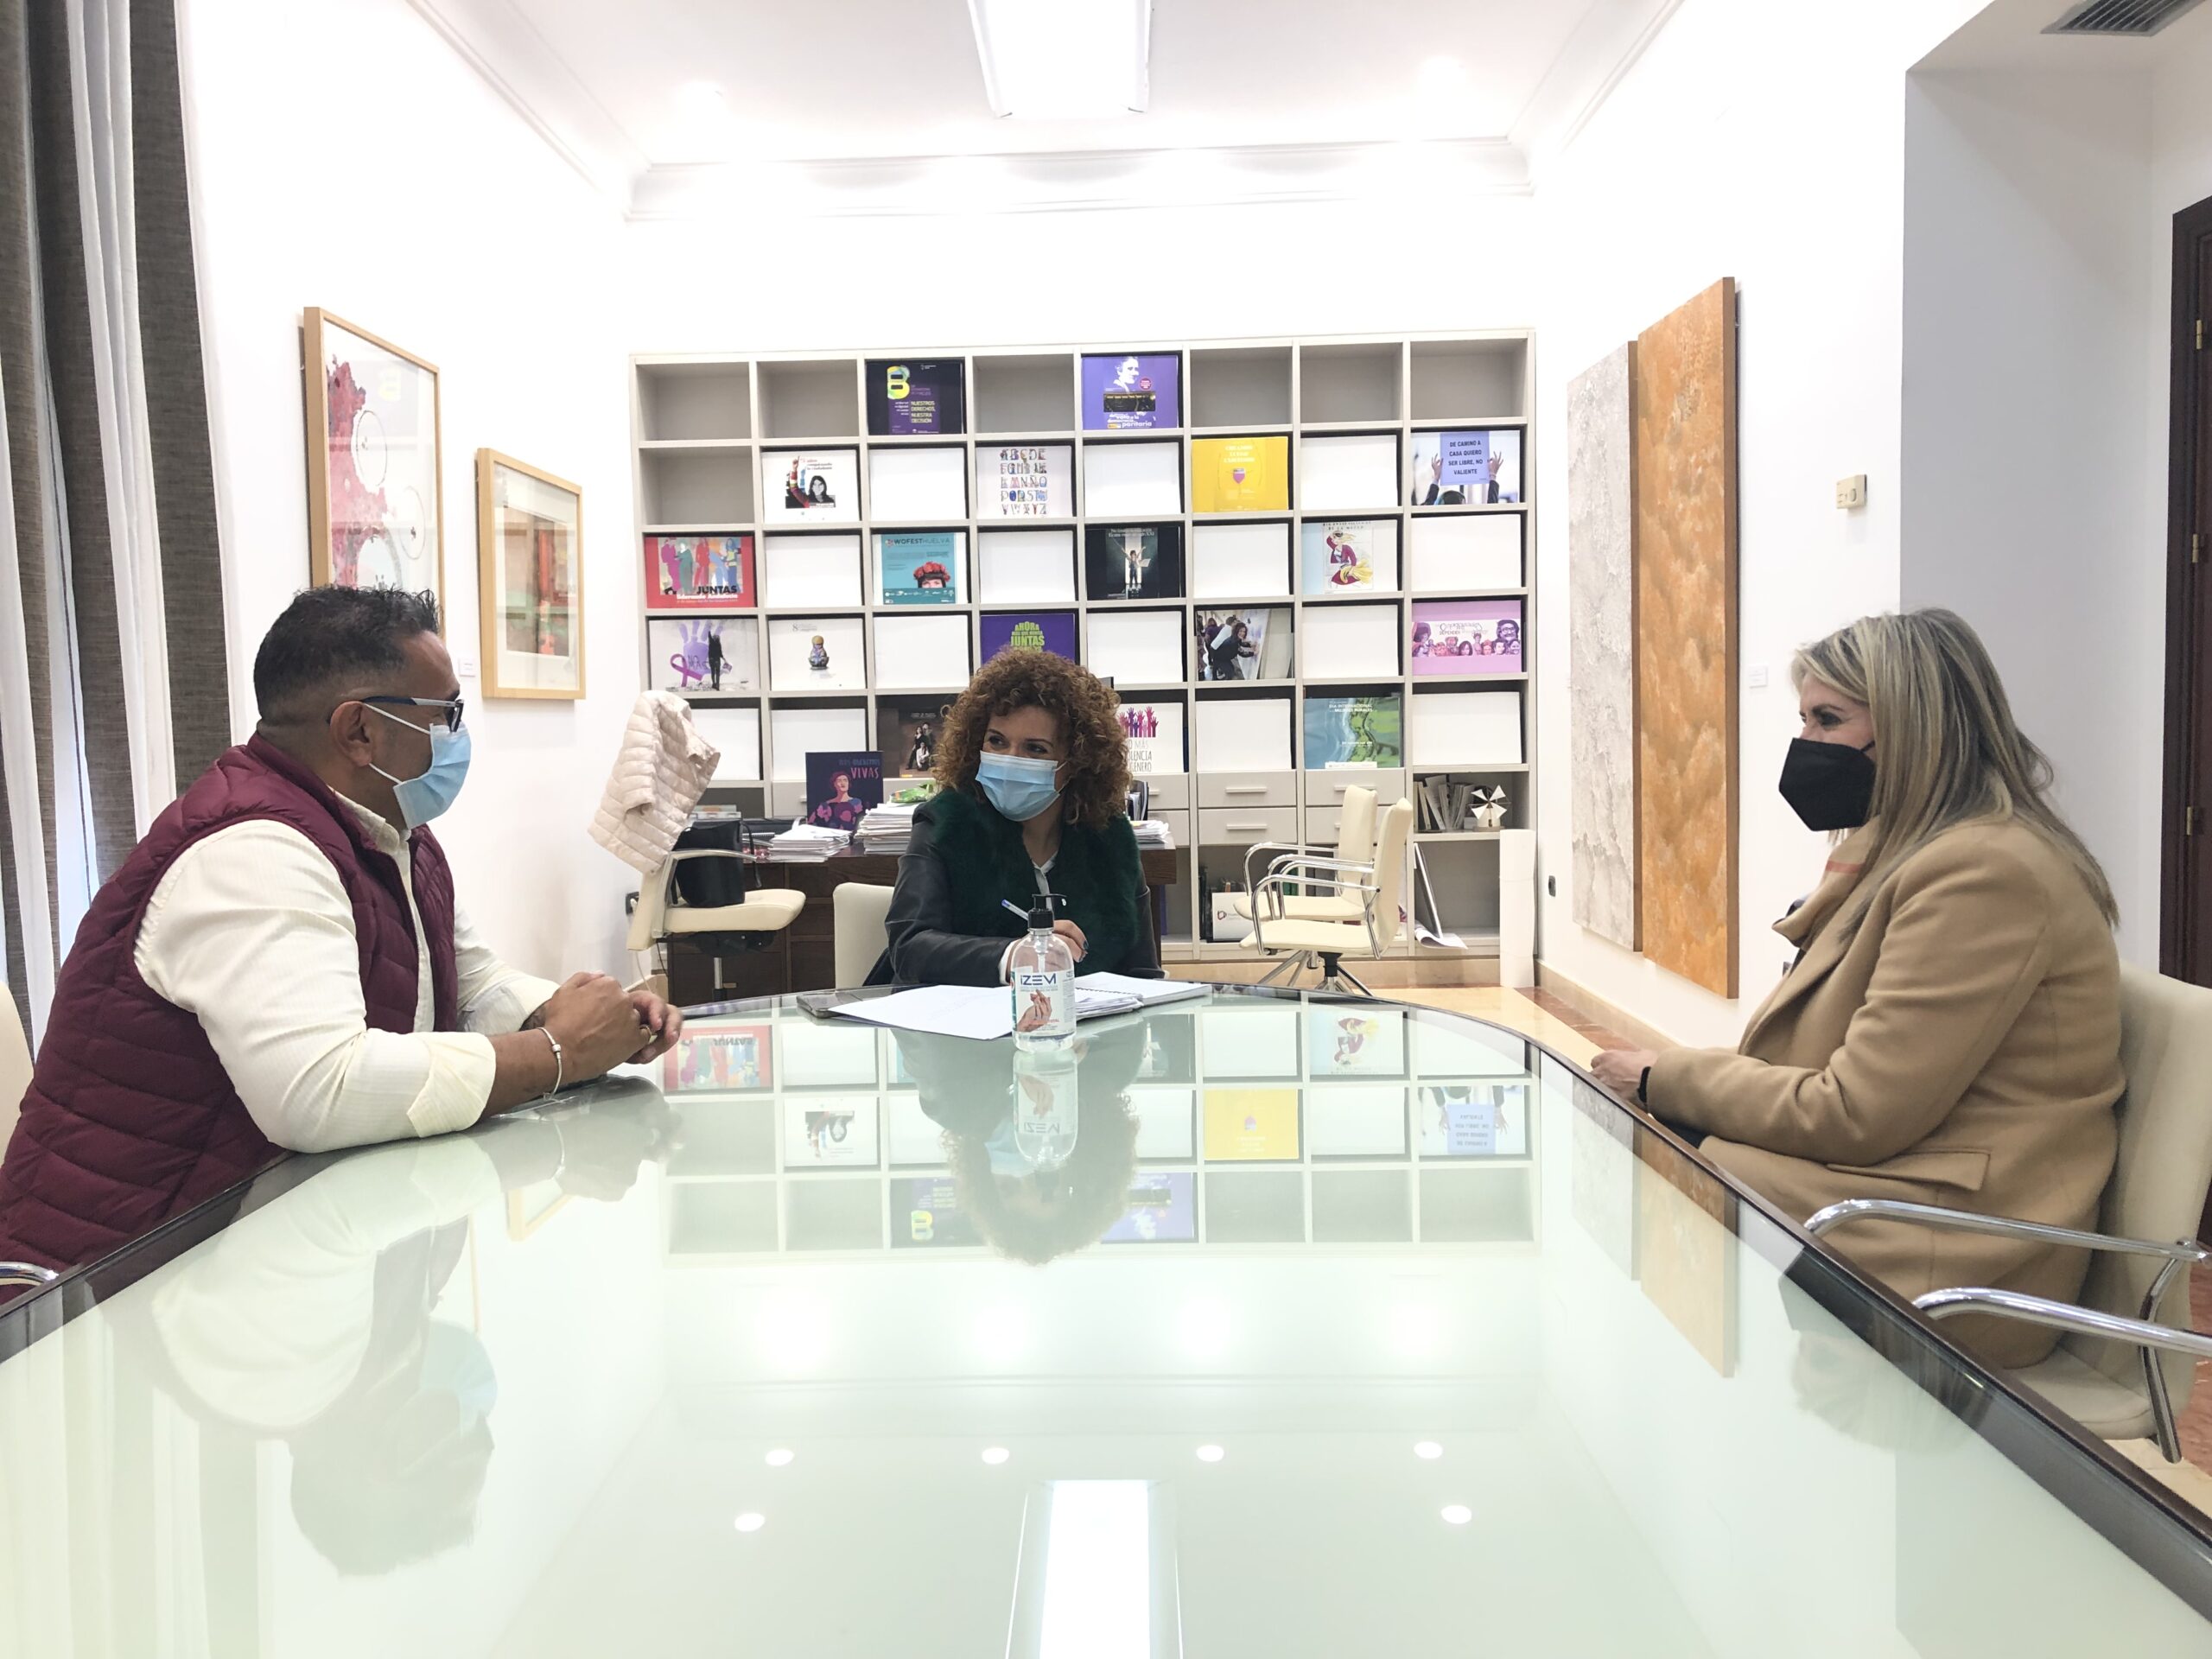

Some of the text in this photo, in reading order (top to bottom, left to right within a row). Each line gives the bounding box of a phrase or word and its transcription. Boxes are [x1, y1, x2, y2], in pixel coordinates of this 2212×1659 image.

[696, 586, 737, 594] JUNTAS
[1010, 635, 1045, 646] JUNTAS
[850, 767, 879, 779] VIVAS
